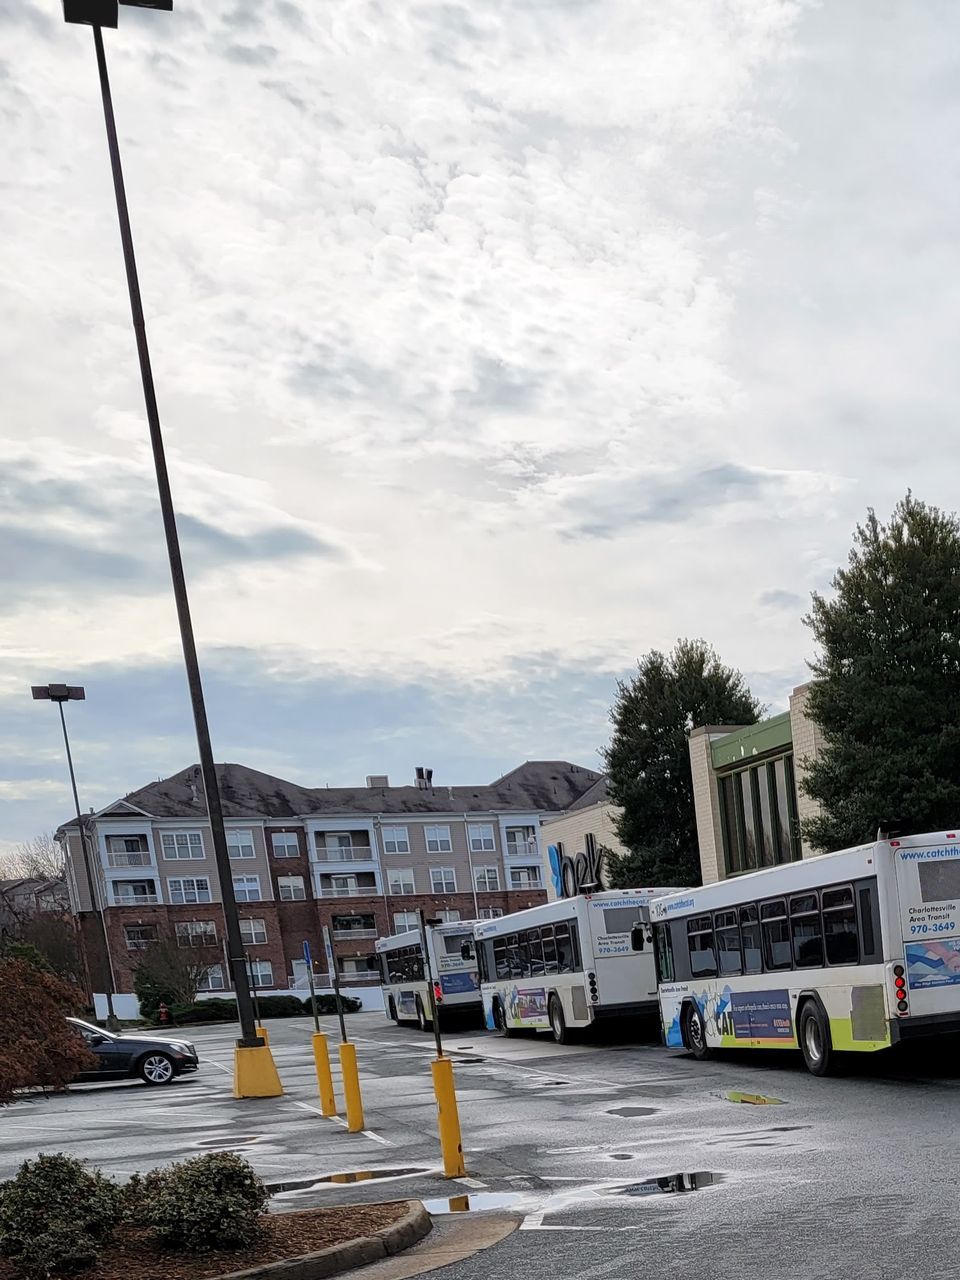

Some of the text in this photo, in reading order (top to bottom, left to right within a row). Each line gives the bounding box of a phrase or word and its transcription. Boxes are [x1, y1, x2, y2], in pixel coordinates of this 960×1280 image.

[557, 833, 603, 897] belk
[908, 903, 956, 914] Charlottesville
[909, 913, 950, 923] Area Transit
[910, 921, 956, 935] 970-3649
